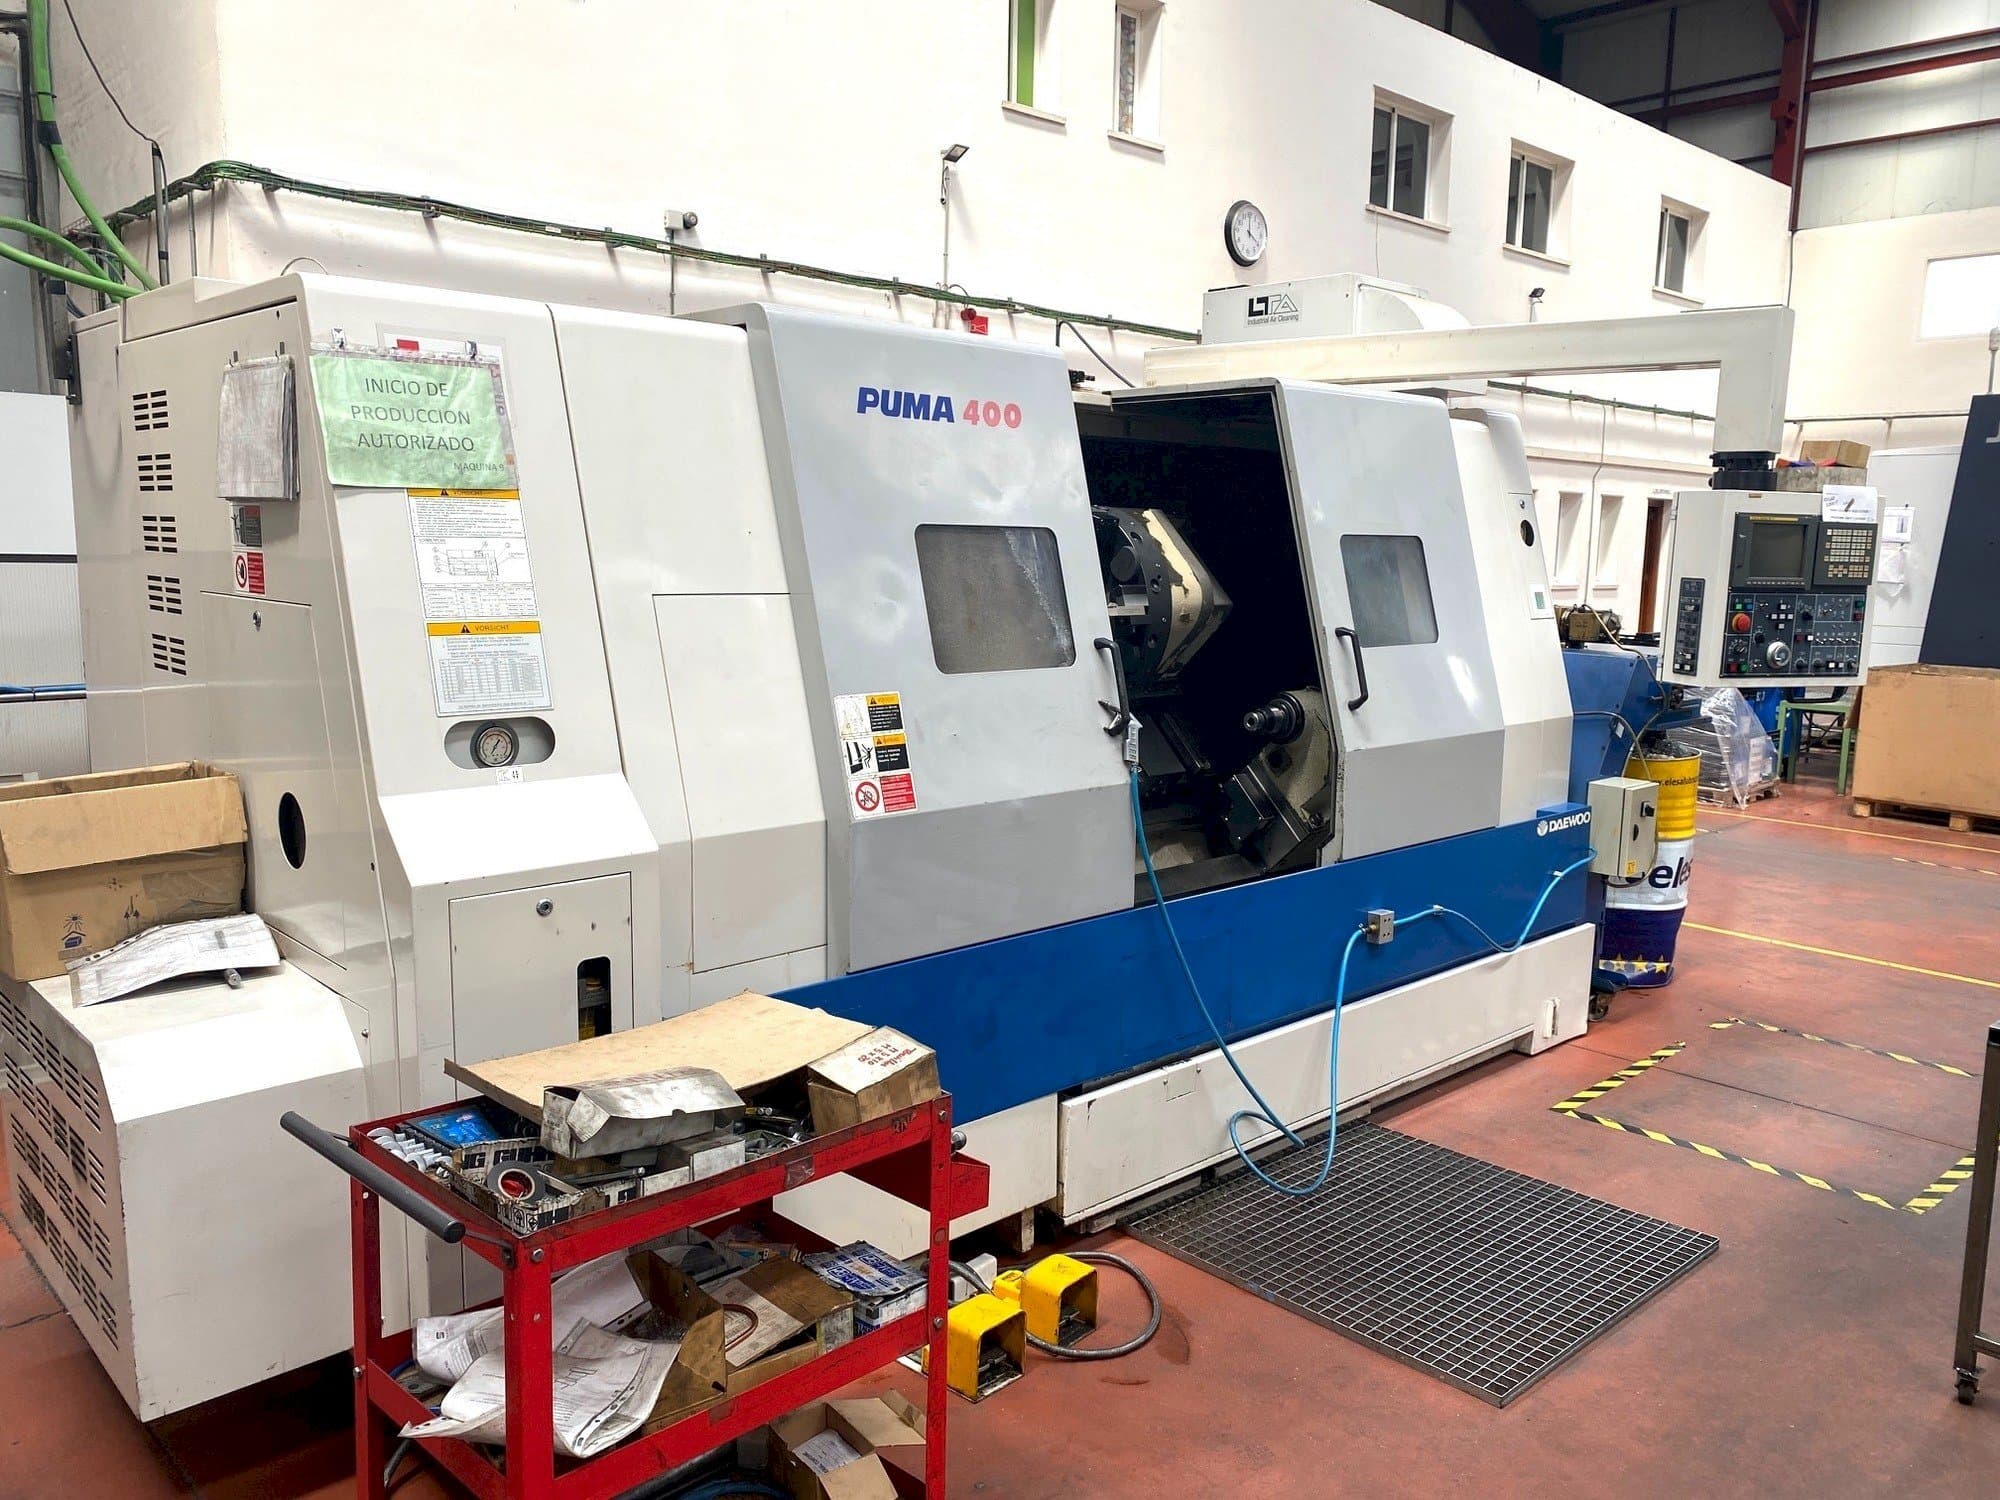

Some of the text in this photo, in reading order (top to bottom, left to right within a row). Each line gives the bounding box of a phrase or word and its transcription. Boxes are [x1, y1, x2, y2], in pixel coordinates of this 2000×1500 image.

[1248, 317, 1269, 325] Industrial
[1278, 314, 1299, 322] Cleaning
[365, 378, 449, 397] INICIO DE
[351, 405, 471, 425] PRODUCCION
[857, 387, 1022, 428] PUMA 400
[357, 432, 474, 451] AUTORIZADO
[453, 462, 498, 471] MAQUINA
[474, 624, 510, 632] VORSICHT
[1549, 811, 1592, 832] DAEWOO
